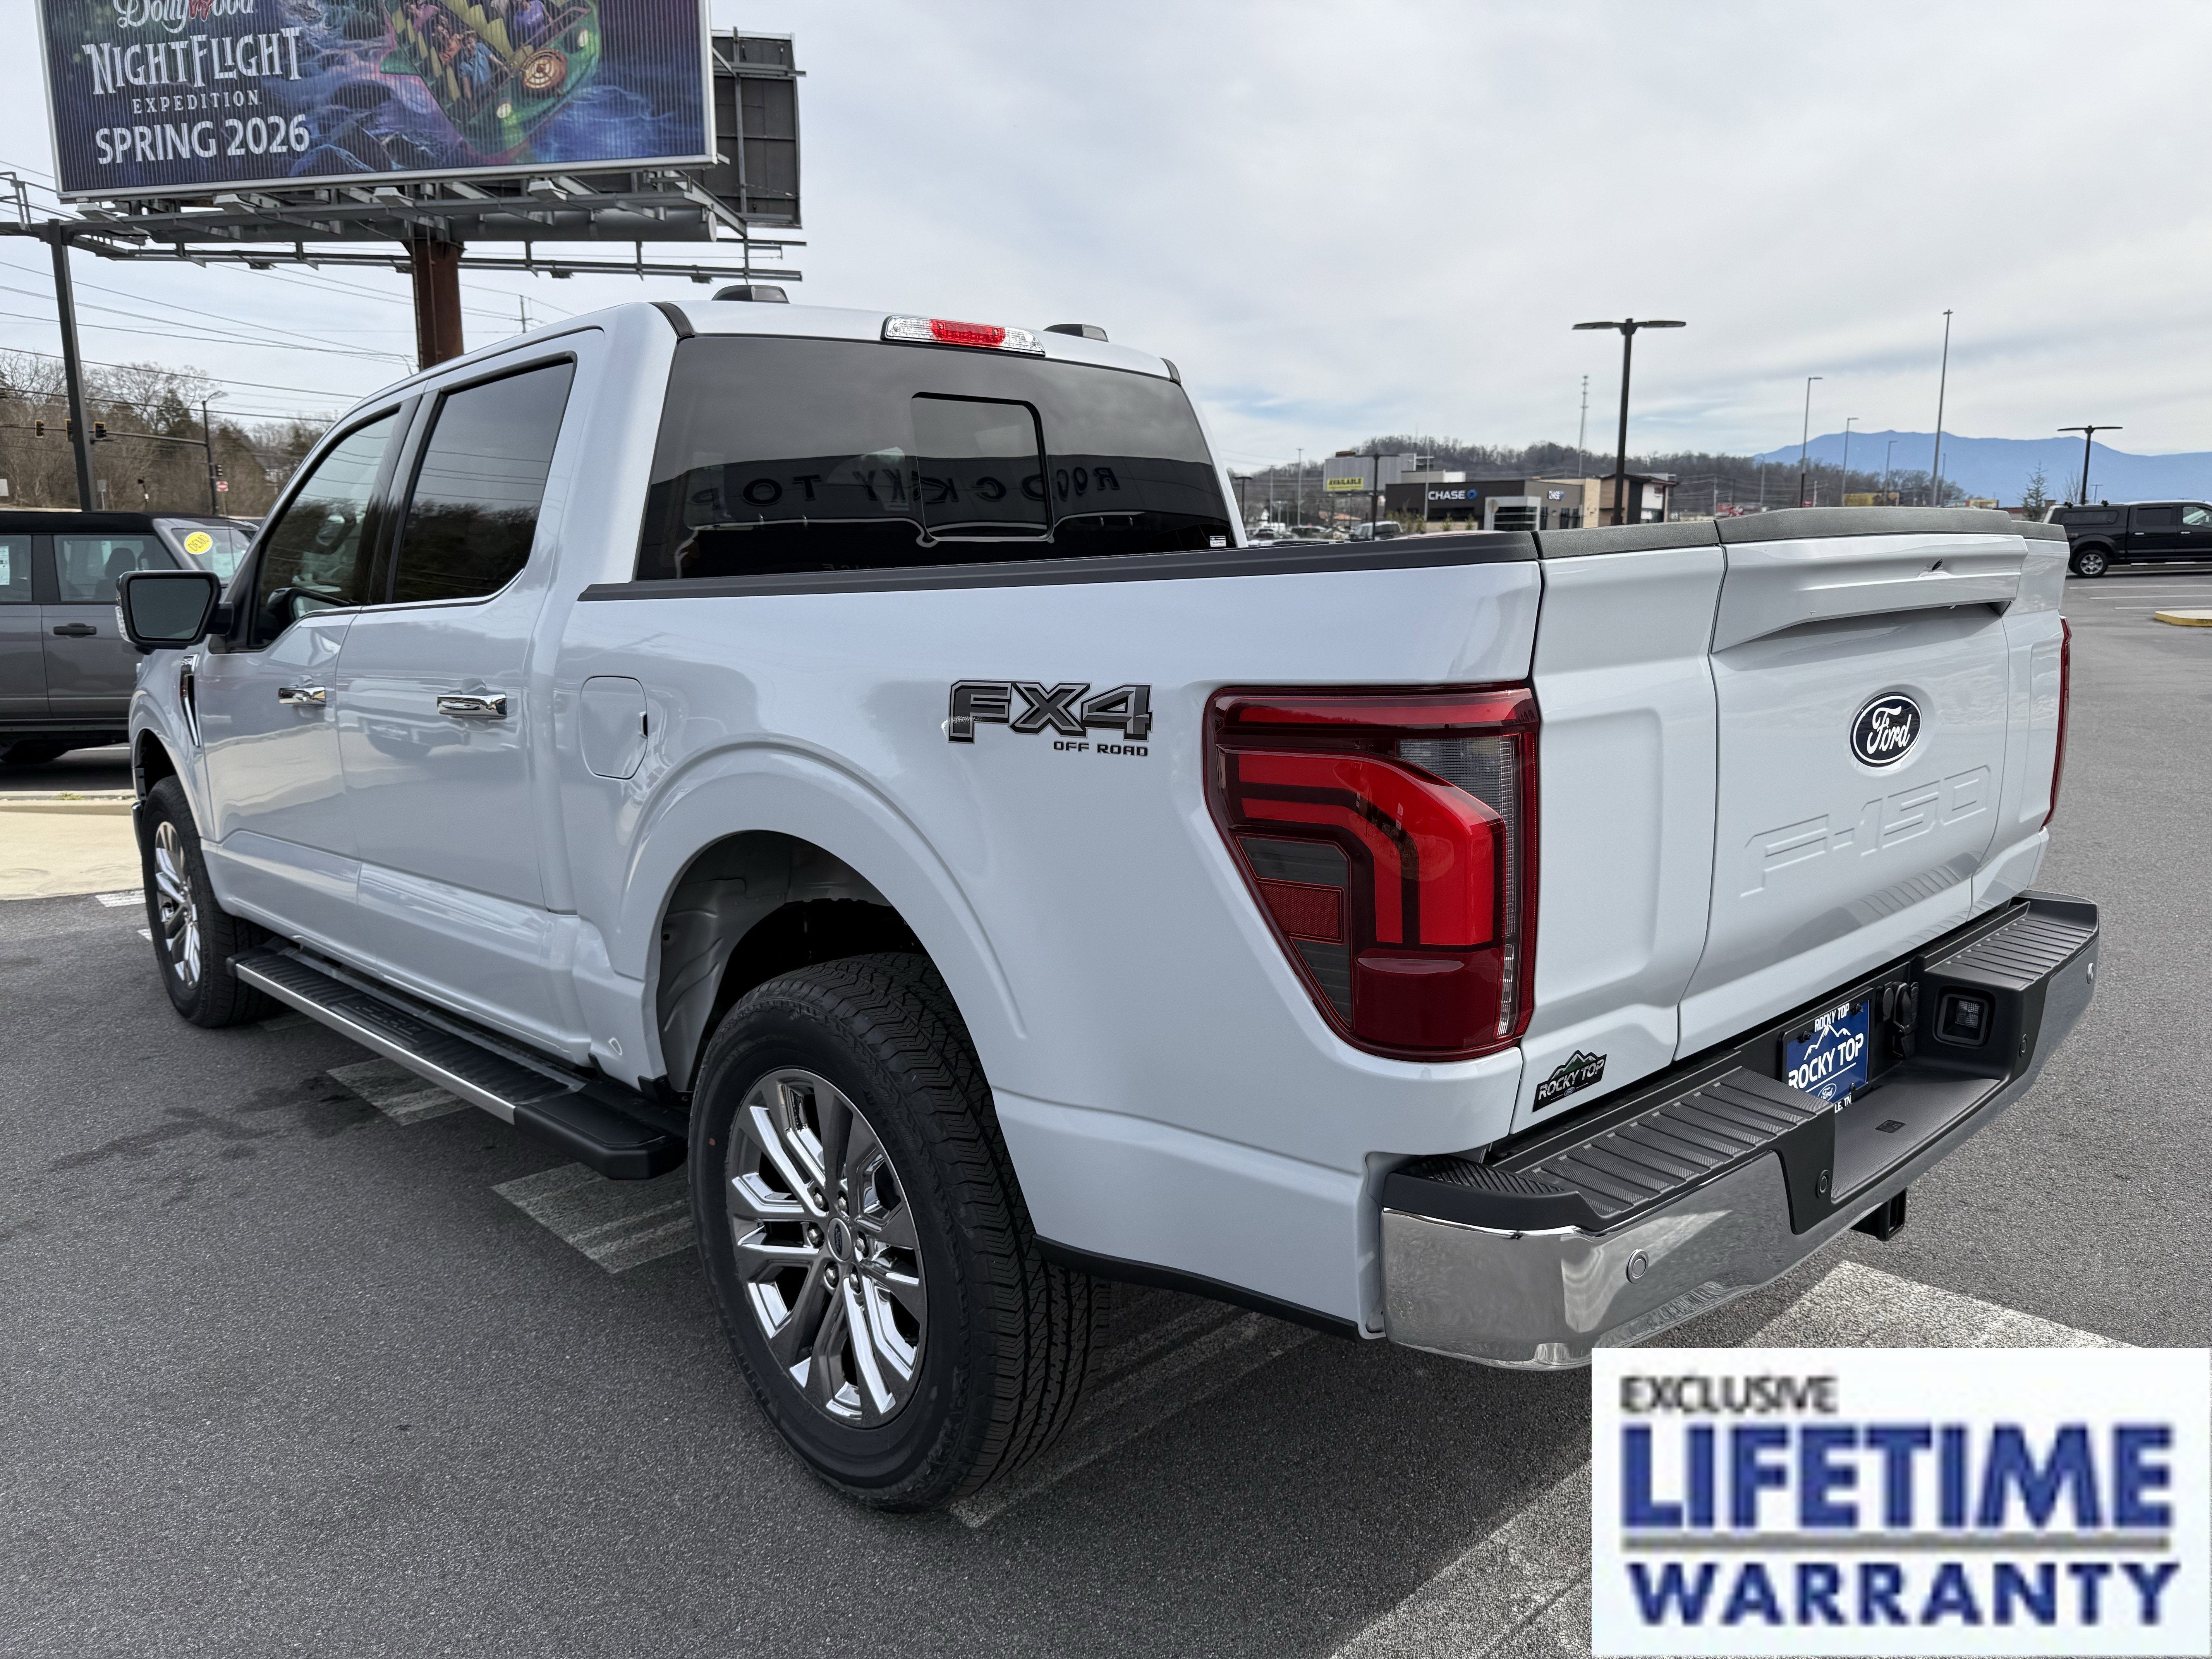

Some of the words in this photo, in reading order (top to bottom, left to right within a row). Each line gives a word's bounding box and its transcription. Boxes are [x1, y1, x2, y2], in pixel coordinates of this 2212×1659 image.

[82, 27, 302, 95] NIGHTFLIGHT
[132, 89, 259, 114] EXPEDITION
[96, 120, 217, 164] SPRING
[225, 114, 309, 156] 2026
[1428, 490, 1466, 500] CHASE
[948, 678, 1153, 744] FX4
[1867, 706, 1912, 754] Ford
[1053, 740, 1090, 752] OFF
[1097, 743, 1149, 756] ROAD
[1740, 764, 1990, 897] F-150
[1815, 1010, 1836, 1032] ROCKY
[1838, 1003, 1850, 1020] TOP
[1538, 1069, 1580, 1100] ROCKY
[1581, 1059, 1604, 1080] TOP
[1788, 1048, 1836, 1089] ROCKY
[1837, 1033, 1864, 1066] TOP
